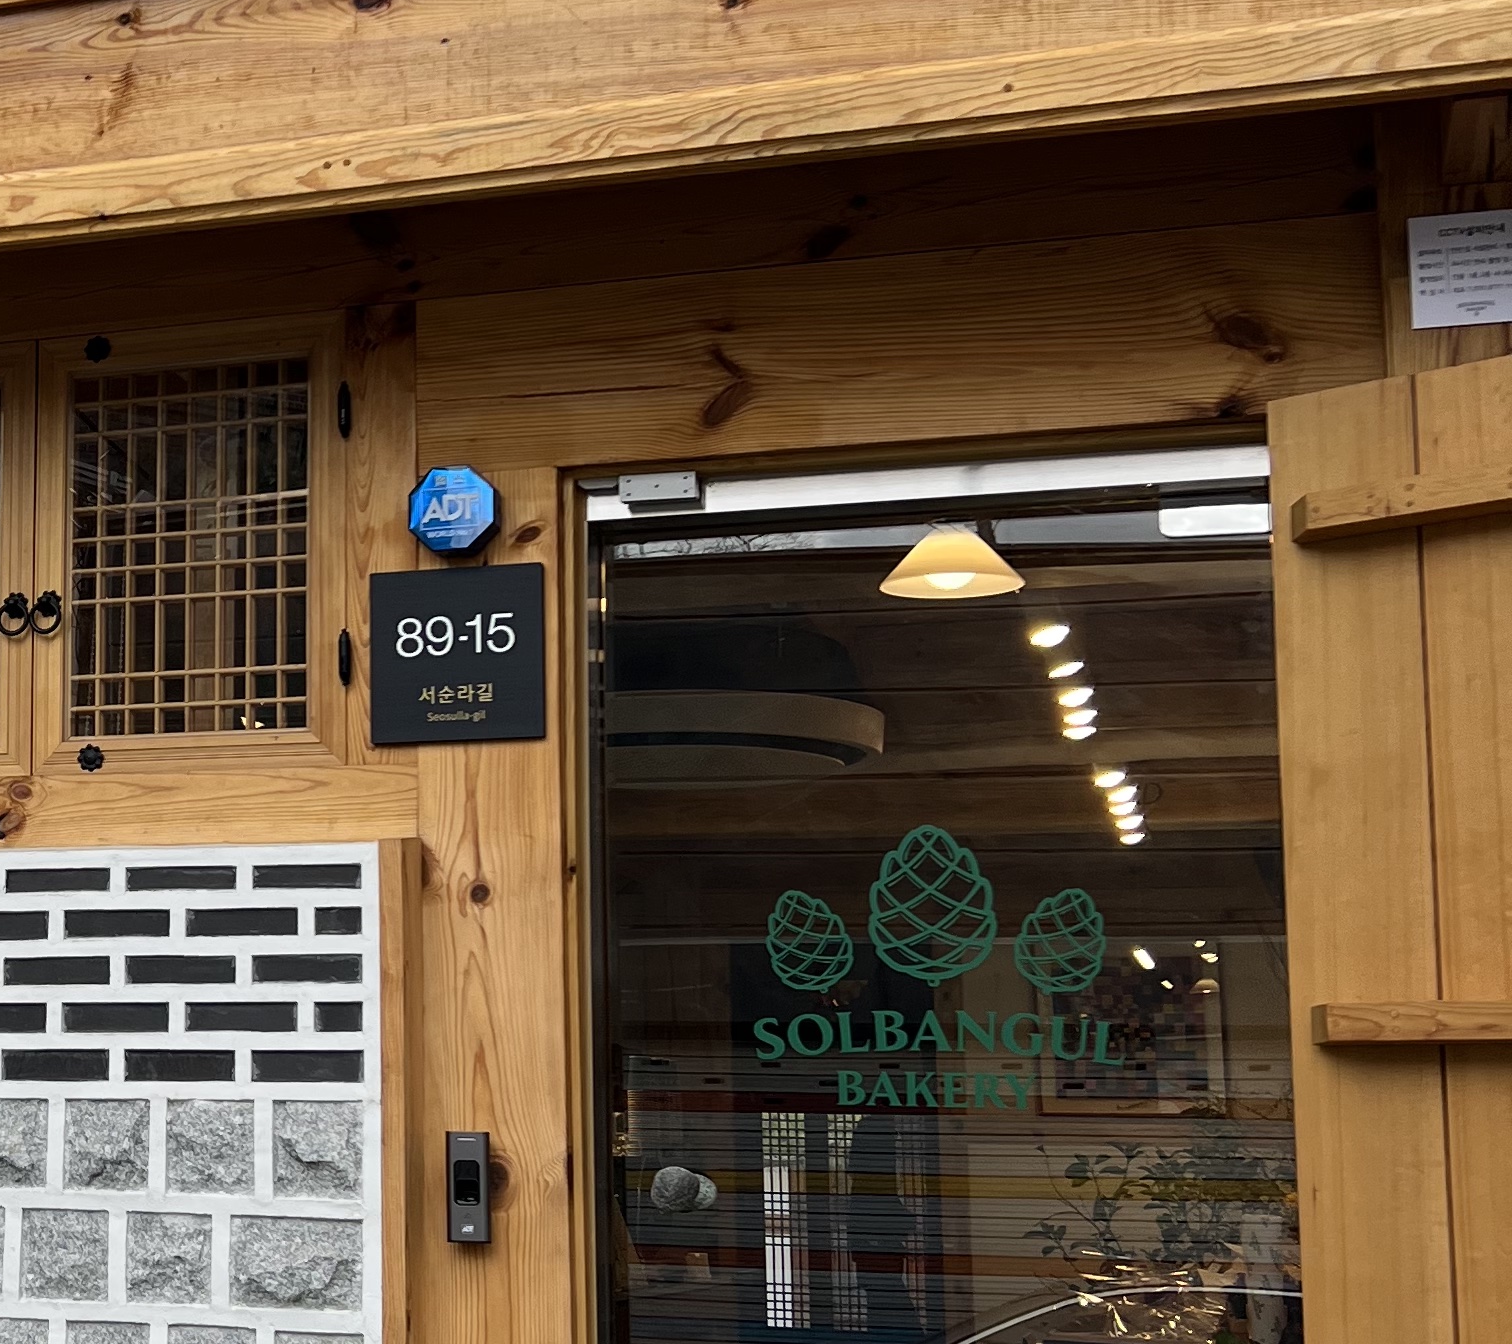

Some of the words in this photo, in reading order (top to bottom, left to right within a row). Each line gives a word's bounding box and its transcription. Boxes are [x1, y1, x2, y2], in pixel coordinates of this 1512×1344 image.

[421, 493, 479, 524] ADT
[395, 612, 516, 658] 89-15
[418, 682, 494, 705] 서순라길
[752, 1010, 1127, 1067] SOLBANGUL
[836, 1070, 1037, 1111] BAKERY
